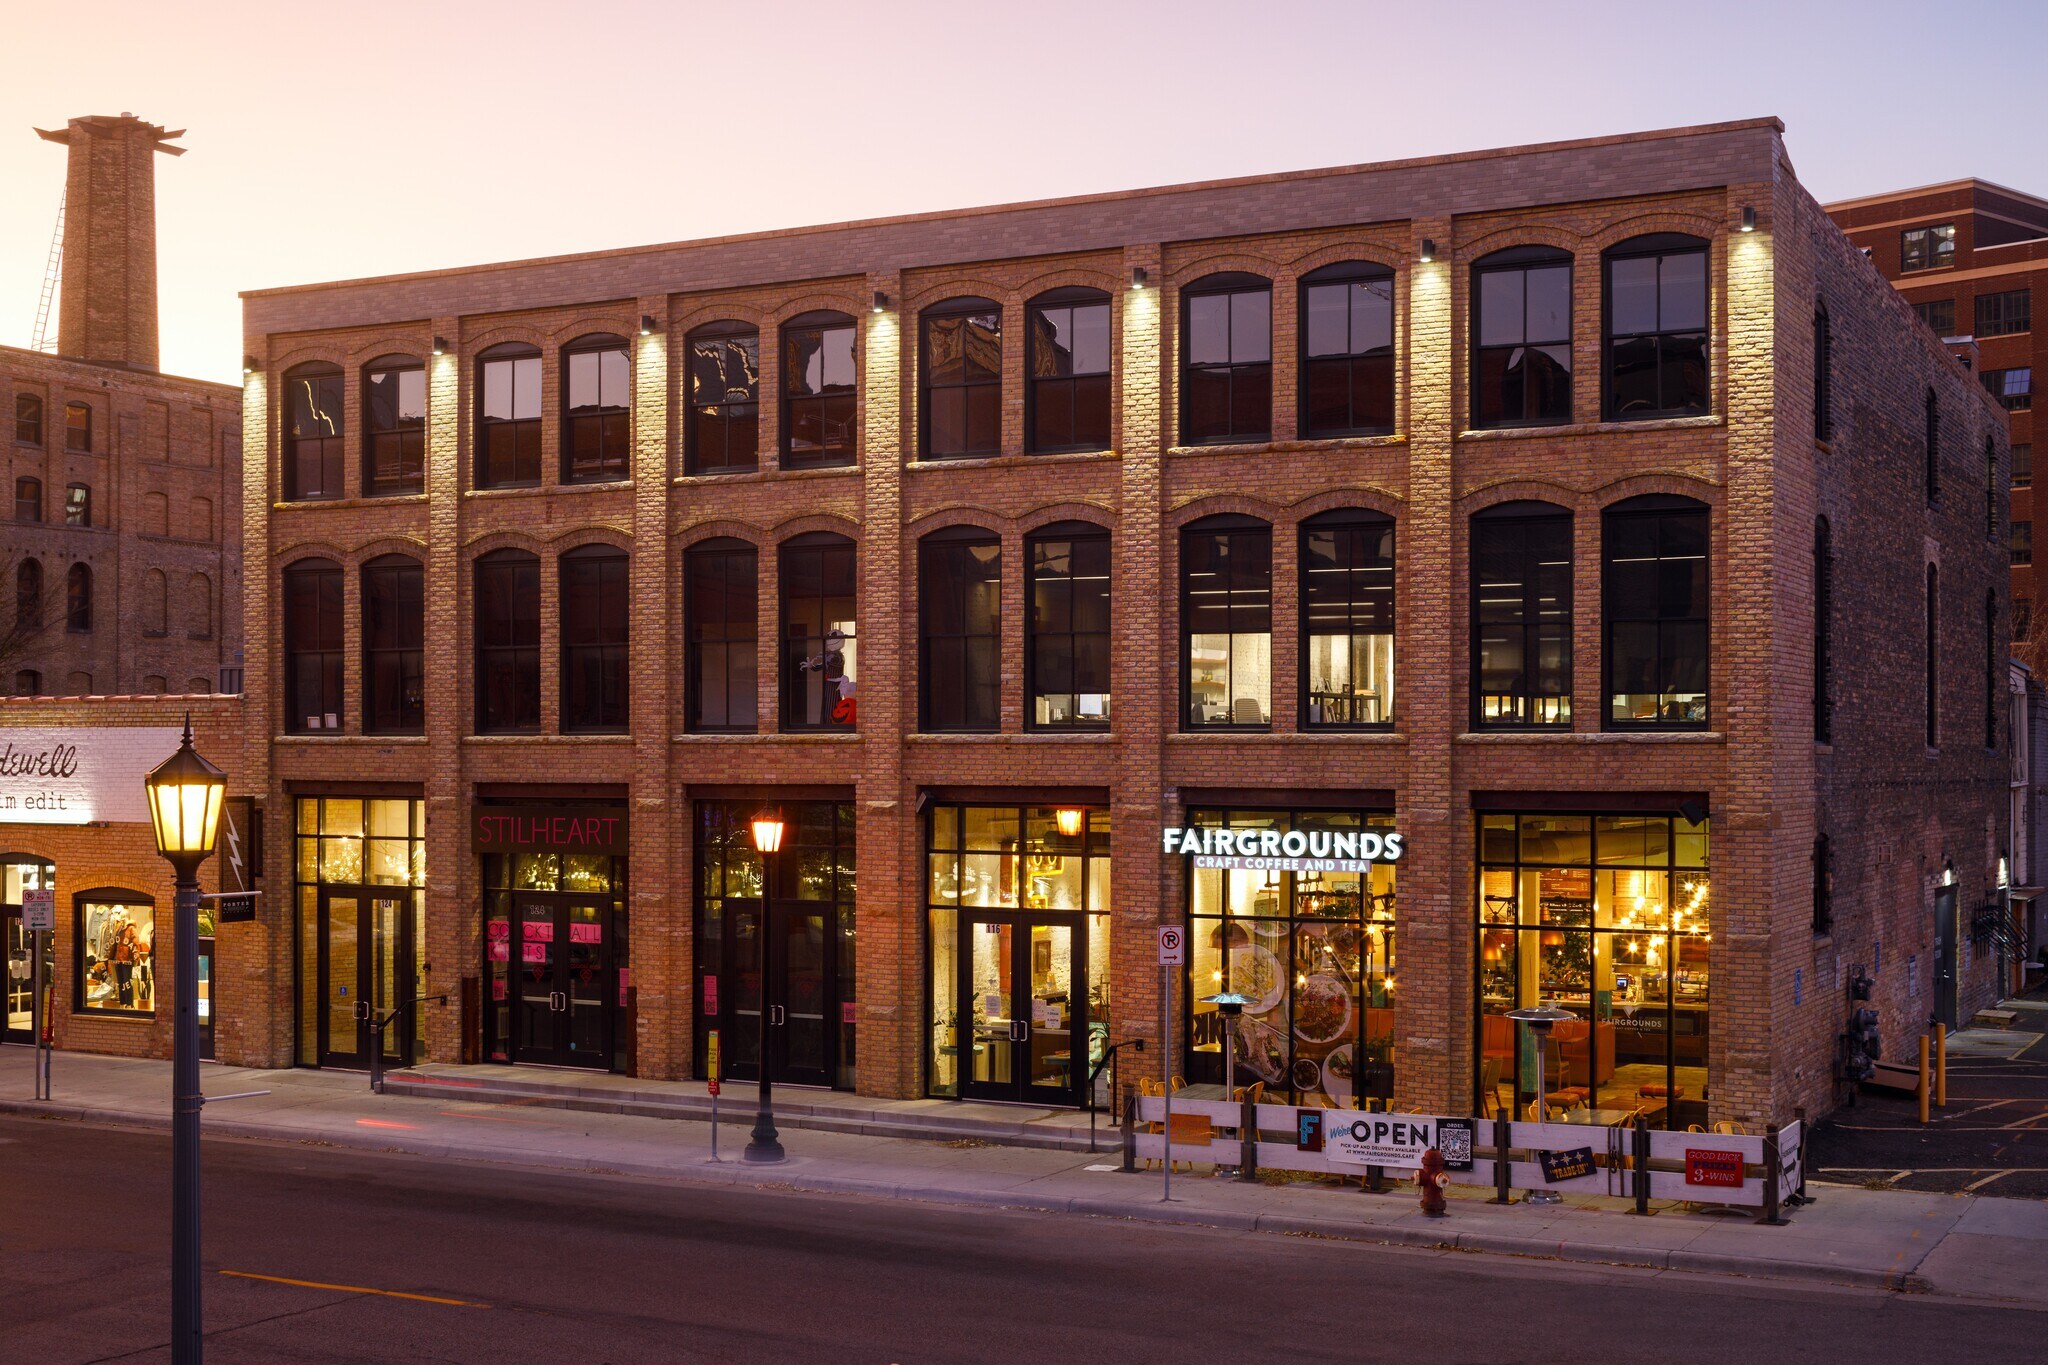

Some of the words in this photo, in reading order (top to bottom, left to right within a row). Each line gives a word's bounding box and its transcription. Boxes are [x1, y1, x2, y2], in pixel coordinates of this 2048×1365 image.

[25, 792, 67, 810] edit
[479, 816, 619, 845] STILHEART
[1163, 827, 1404, 861] FAIRGROUNDS
[1196, 857, 1239, 868] CRAFT
[1245, 858, 1299, 870] COFFEE
[1304, 860, 1335, 871] AND
[1340, 860, 1367, 872] TEA
[381, 899, 392, 908] 124
[530, 905, 545, 915] 124
[986, 923, 1001, 934] 116
[1601, 1017, 1663, 1028] FAIRGROUNDS
[1330, 1124, 1351, 1139] We're
[1350, 1120, 1429, 1147] OPEN
[1352, 1150, 1415, 1159] WWW.FAIRGROUNDS.CAFE
[1688, 1151, 1716, 1160] GOOD
[1717, 1153, 1741, 1162] LUCK
[1693, 1161, 1736, 1171] PRIZES
[1694, 1168, 1735, 1182] 3-WINS
